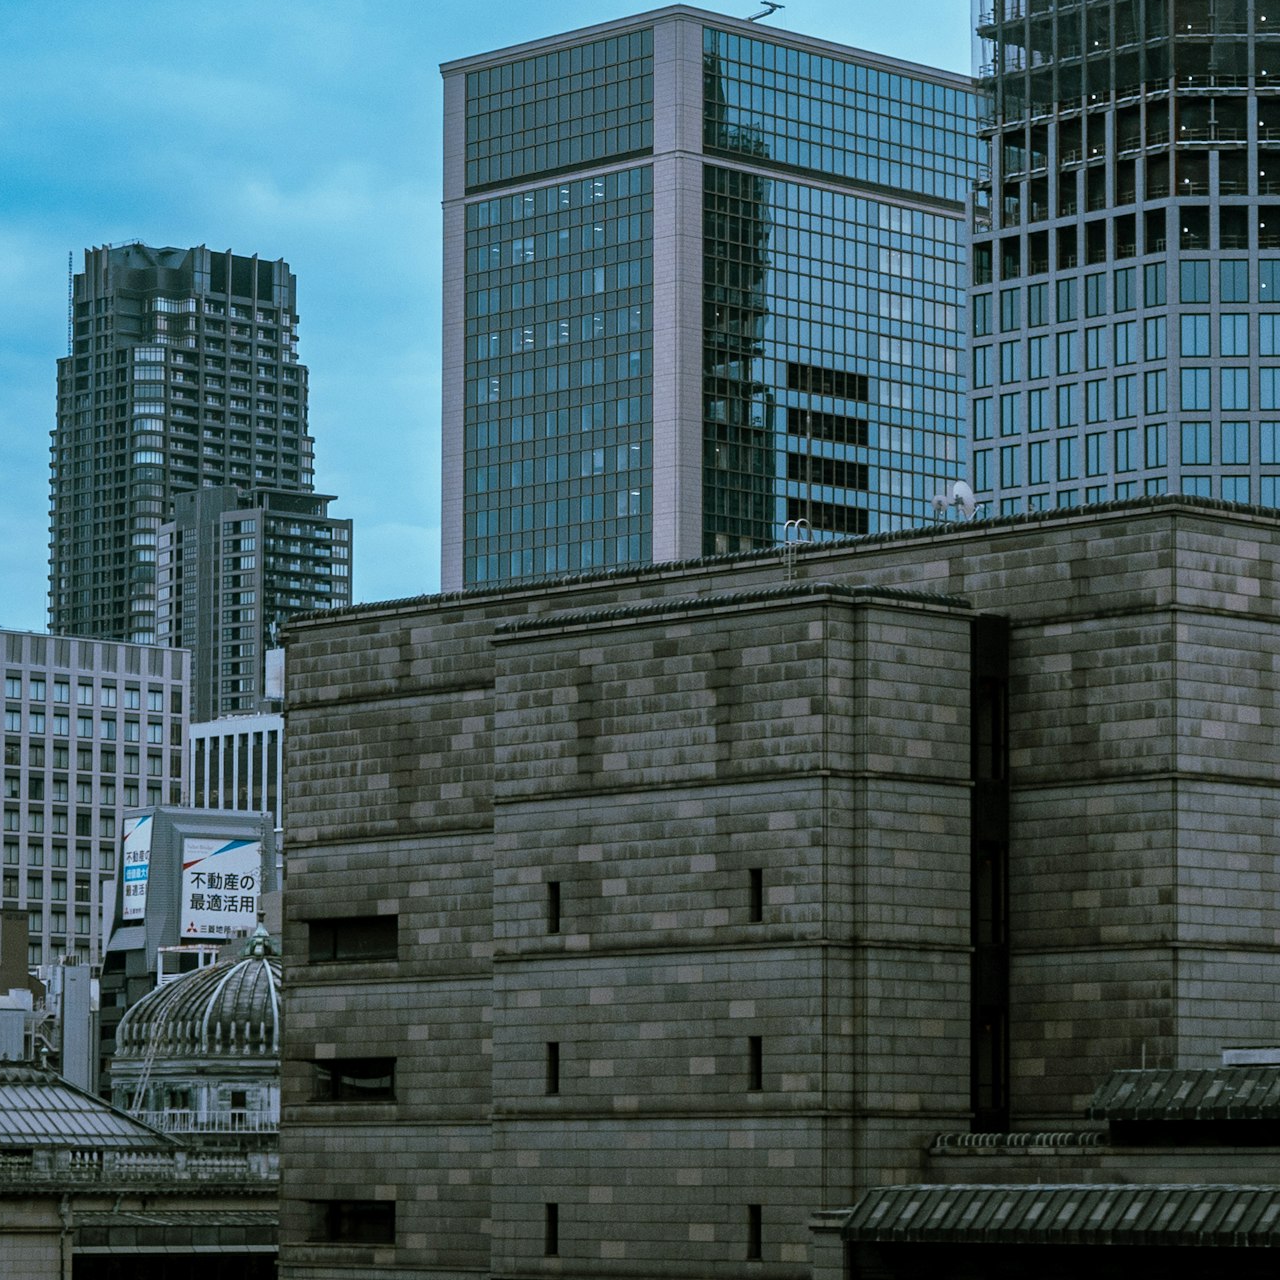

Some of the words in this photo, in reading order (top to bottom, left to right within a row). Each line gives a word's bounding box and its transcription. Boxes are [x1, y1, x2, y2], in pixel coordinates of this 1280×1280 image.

[190, 872, 255, 891] 不動産の
[190, 893, 254, 913] 最適活用
